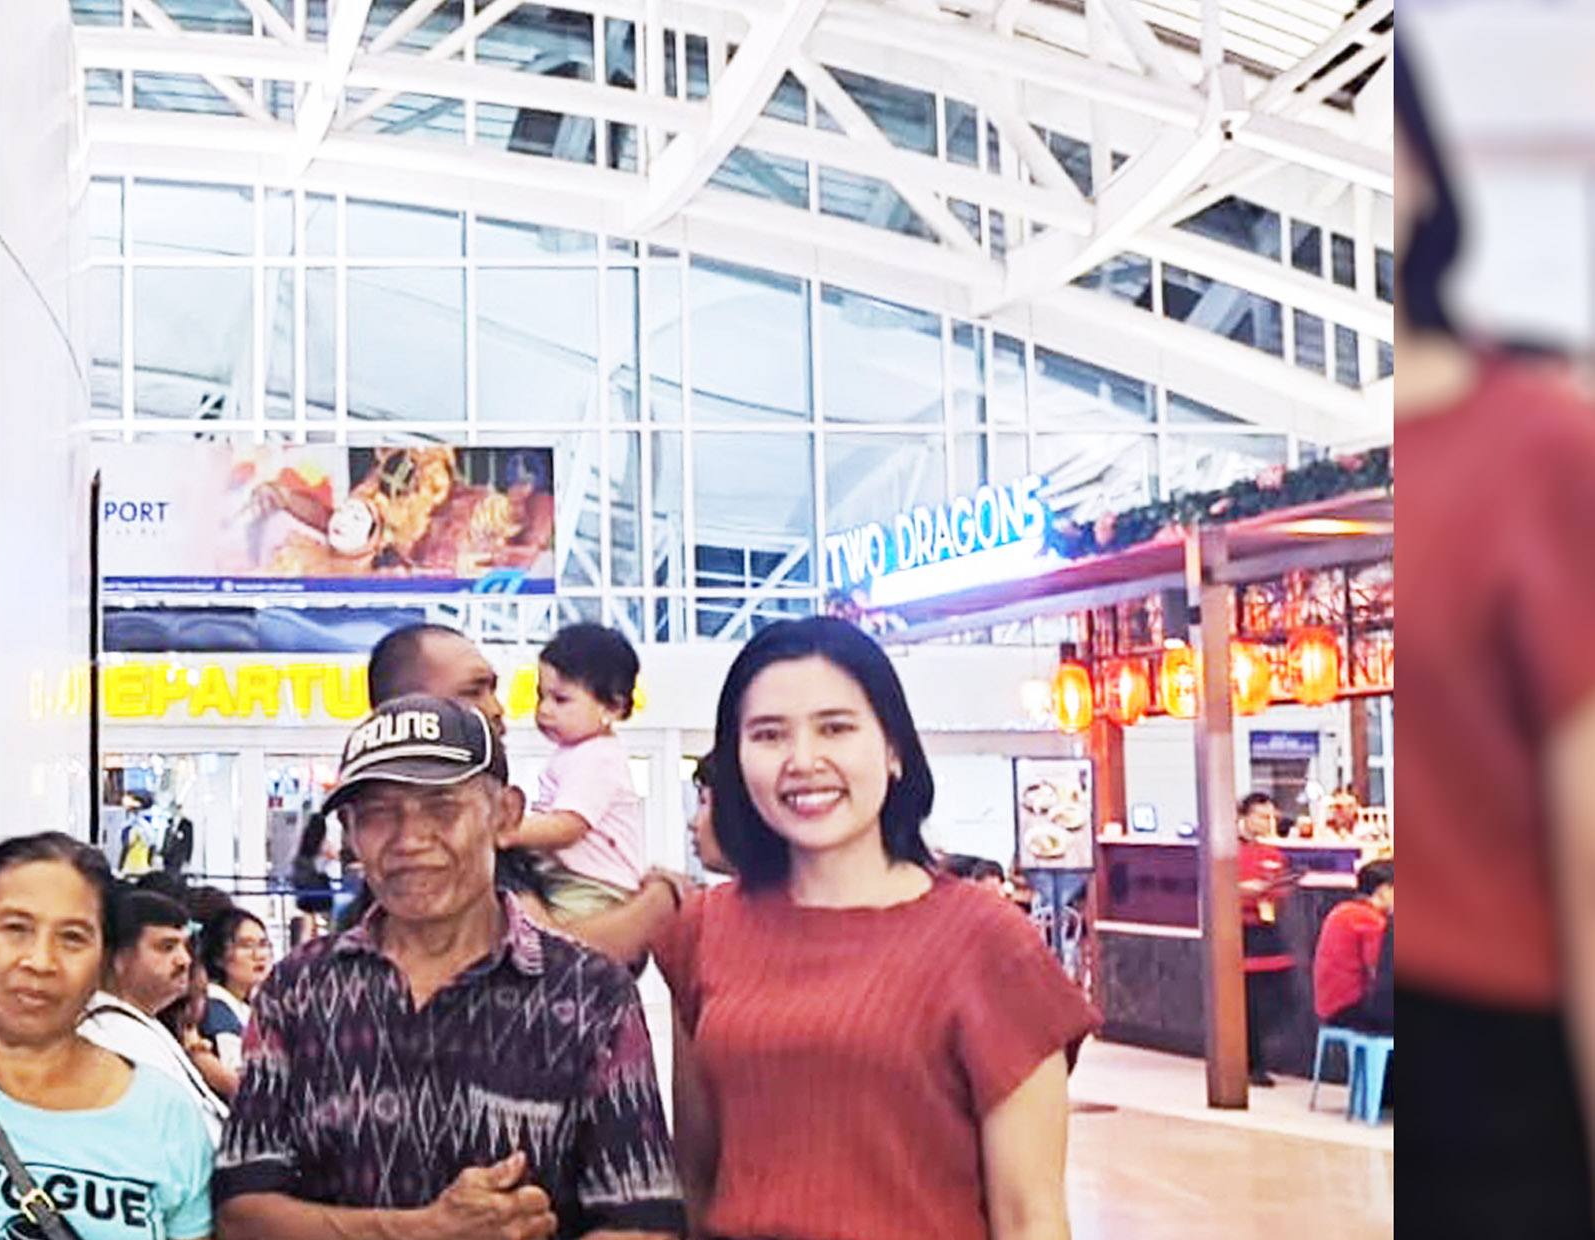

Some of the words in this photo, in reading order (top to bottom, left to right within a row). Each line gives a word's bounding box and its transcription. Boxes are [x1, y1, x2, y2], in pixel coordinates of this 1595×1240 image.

[825, 521, 886, 589] TWO
[894, 473, 1046, 571] DRAGONS
[103, 661, 370, 719] EPARTU
